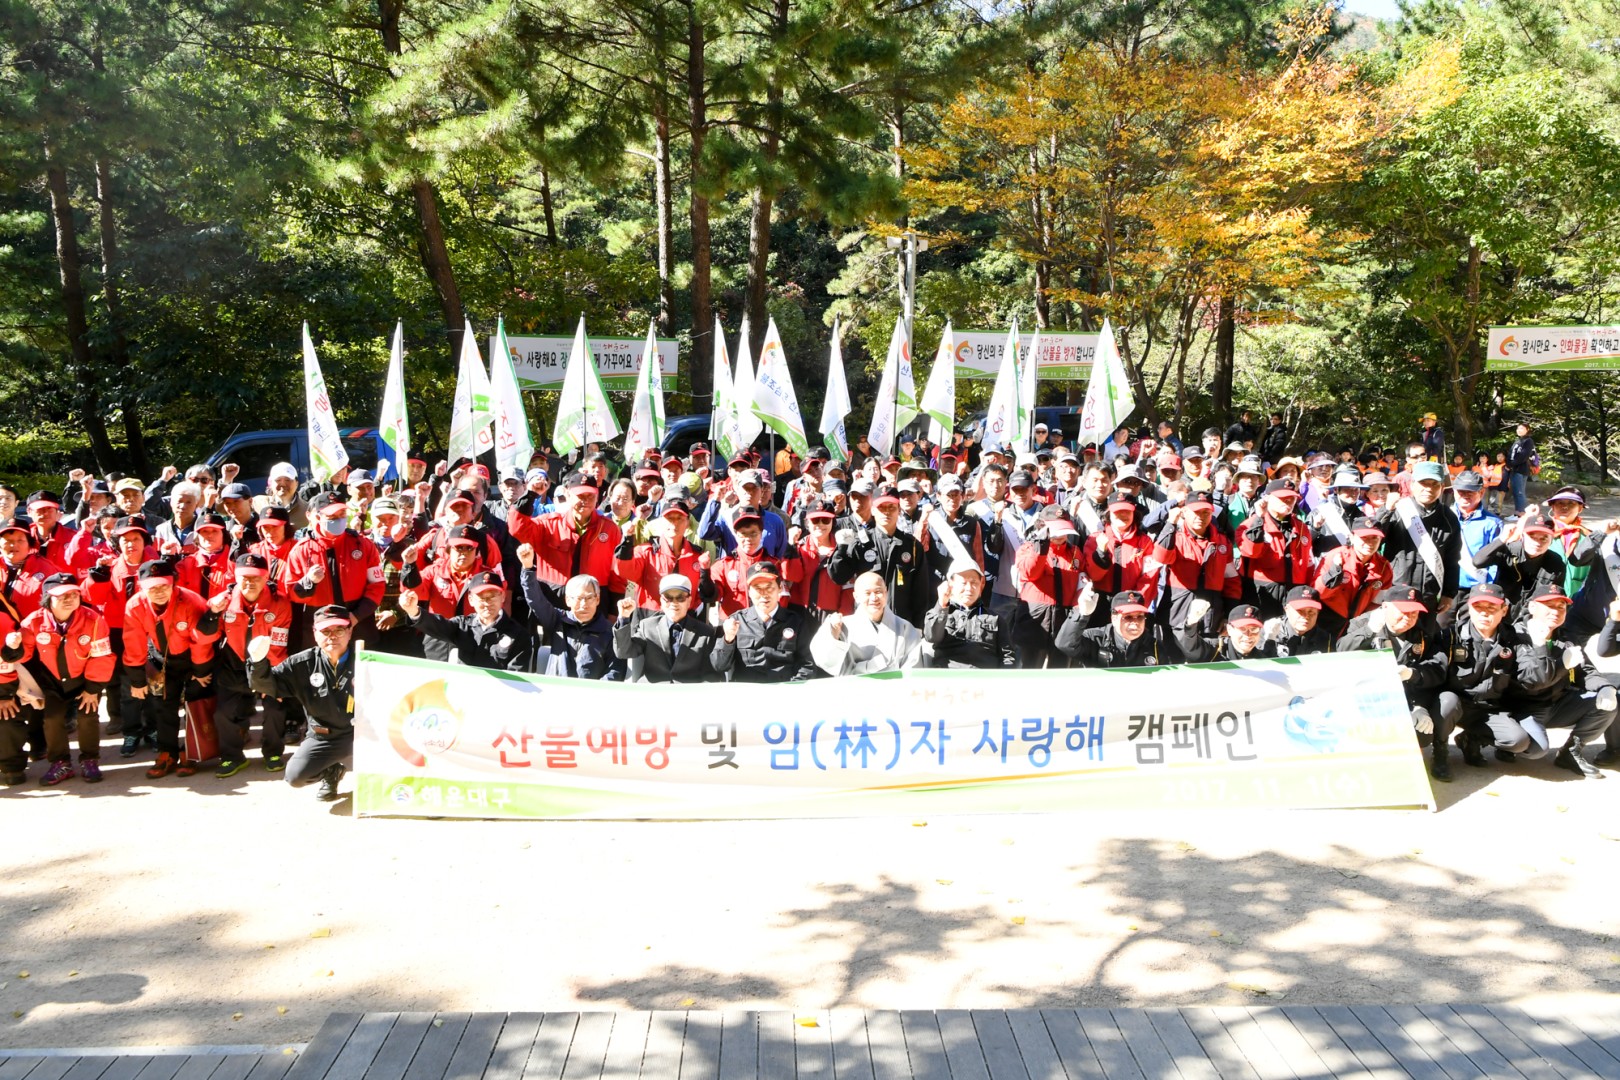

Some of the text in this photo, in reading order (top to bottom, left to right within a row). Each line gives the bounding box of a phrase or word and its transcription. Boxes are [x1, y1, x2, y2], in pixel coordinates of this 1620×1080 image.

[977, 344, 996, 360] 당신의
[1042, 346, 1061, 362] 산불을
[1064, 346, 1095, 361] 방지합니다
[1522, 339, 1550, 354] 잠시만요
[1560, 338, 1588, 354] 인화물질
[1591, 338, 1619, 353] 확인하고
[526, 352, 557, 370] 사랑해요
[603, 353, 632, 370] 가꾸어요
[700, 721, 740, 770] 및
[763, 717, 951, 771] 임(林)자
[972, 714, 1104, 769] 사랑해
[1128, 711, 1258, 765] 캠페인
[421, 785, 512, 809] 해운대구
[1160, 778, 1240, 801] 2017.
[1252, 775, 1293, 800] 11.
